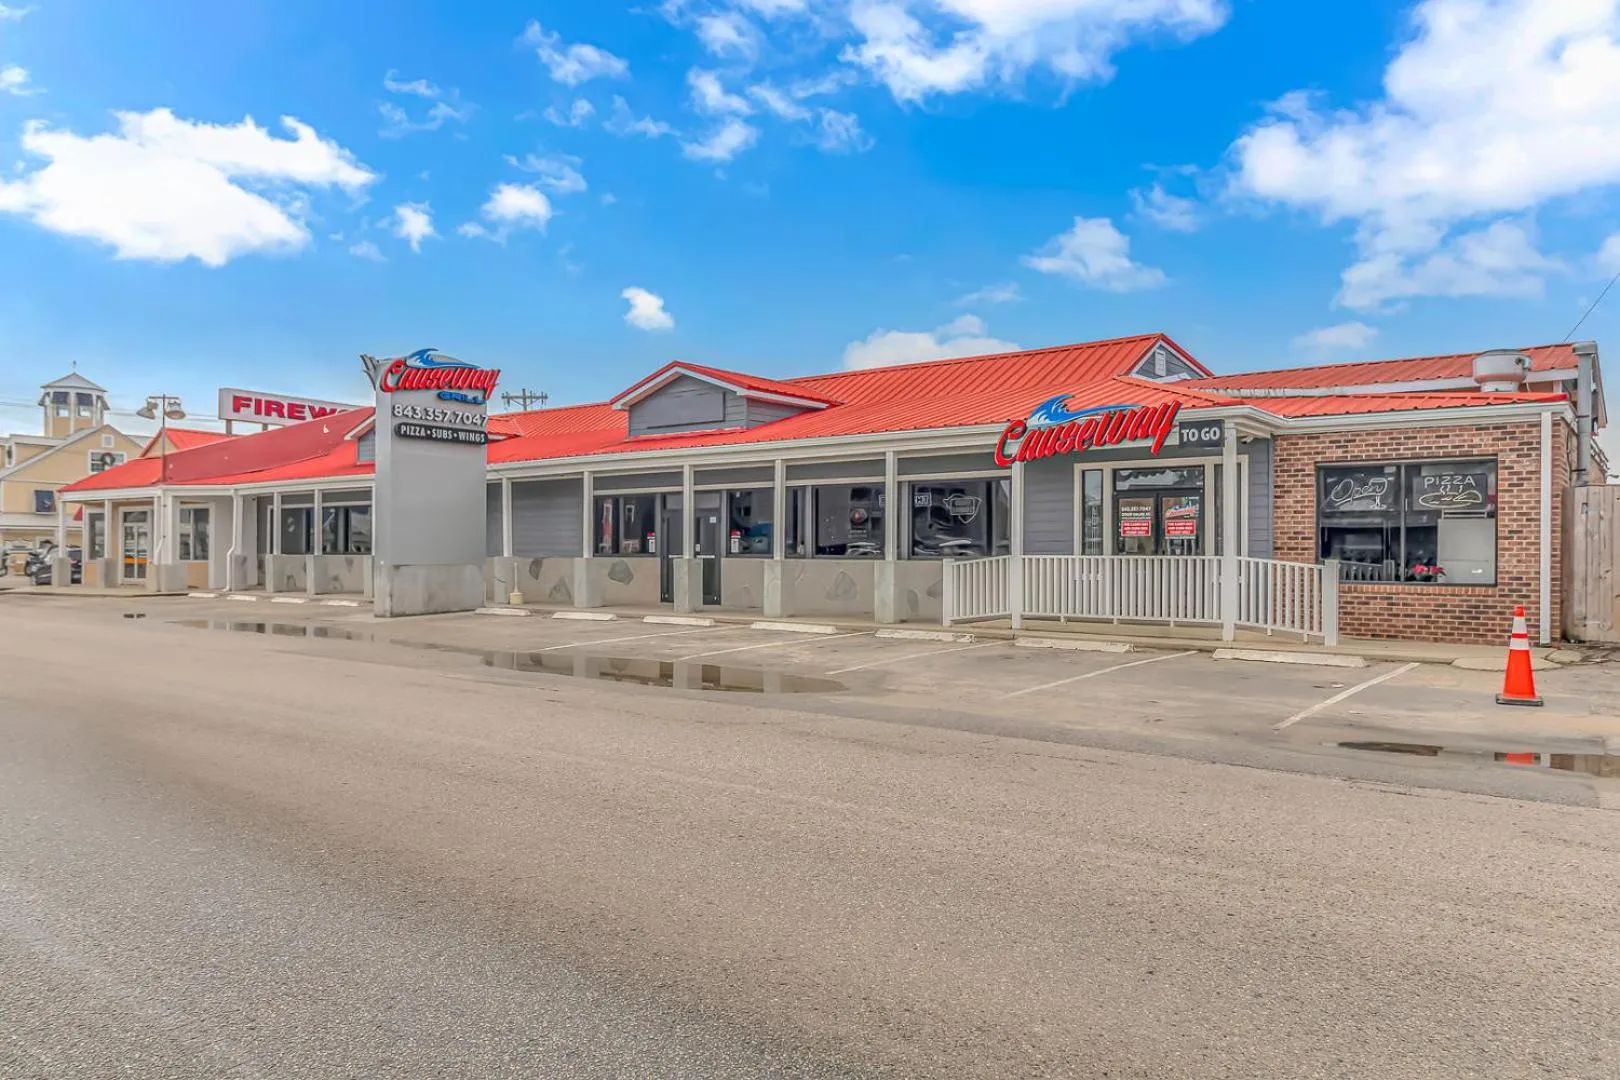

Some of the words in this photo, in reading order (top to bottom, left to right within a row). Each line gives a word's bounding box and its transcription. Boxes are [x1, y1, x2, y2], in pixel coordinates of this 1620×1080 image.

[380, 359, 501, 401] Causeway
[232, 394, 346, 421] FIREW
[393, 404, 489, 427] 843.357.7047
[400, 424, 426, 437] PIZZA
[431, 428, 453, 440] SUBS
[458, 431, 486, 443] WINGS
[994, 400, 1182, 467] Causeway
[1181, 428, 1200, 442] TO
[1200, 426, 1221, 441] GO
[1331, 478, 1383, 503] Open
[1423, 474, 1476, 489] PIZZA
